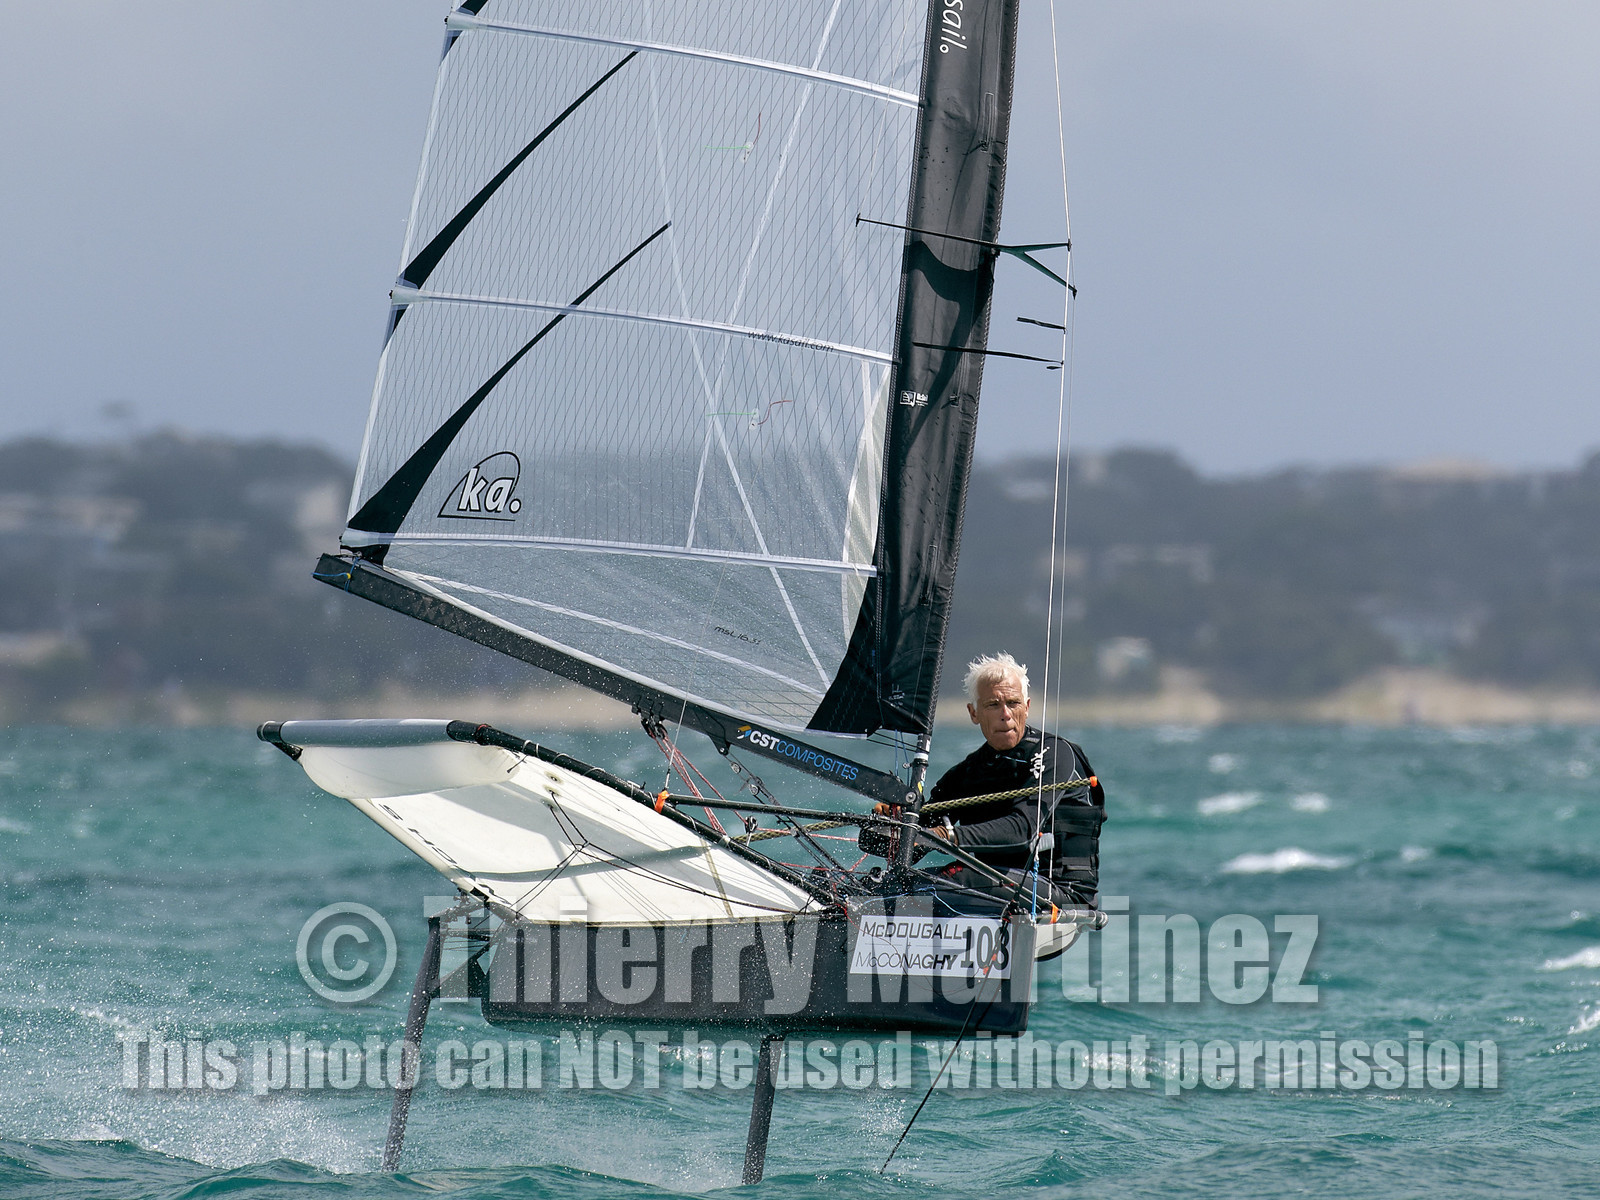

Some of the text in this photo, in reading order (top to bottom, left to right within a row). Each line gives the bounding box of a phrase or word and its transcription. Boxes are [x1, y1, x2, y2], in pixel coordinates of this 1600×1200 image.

[862, 921, 963, 940] McDOUGALL
[960, 925, 1010, 970] 108
[855, 952, 958, 970] McCONAGHY
